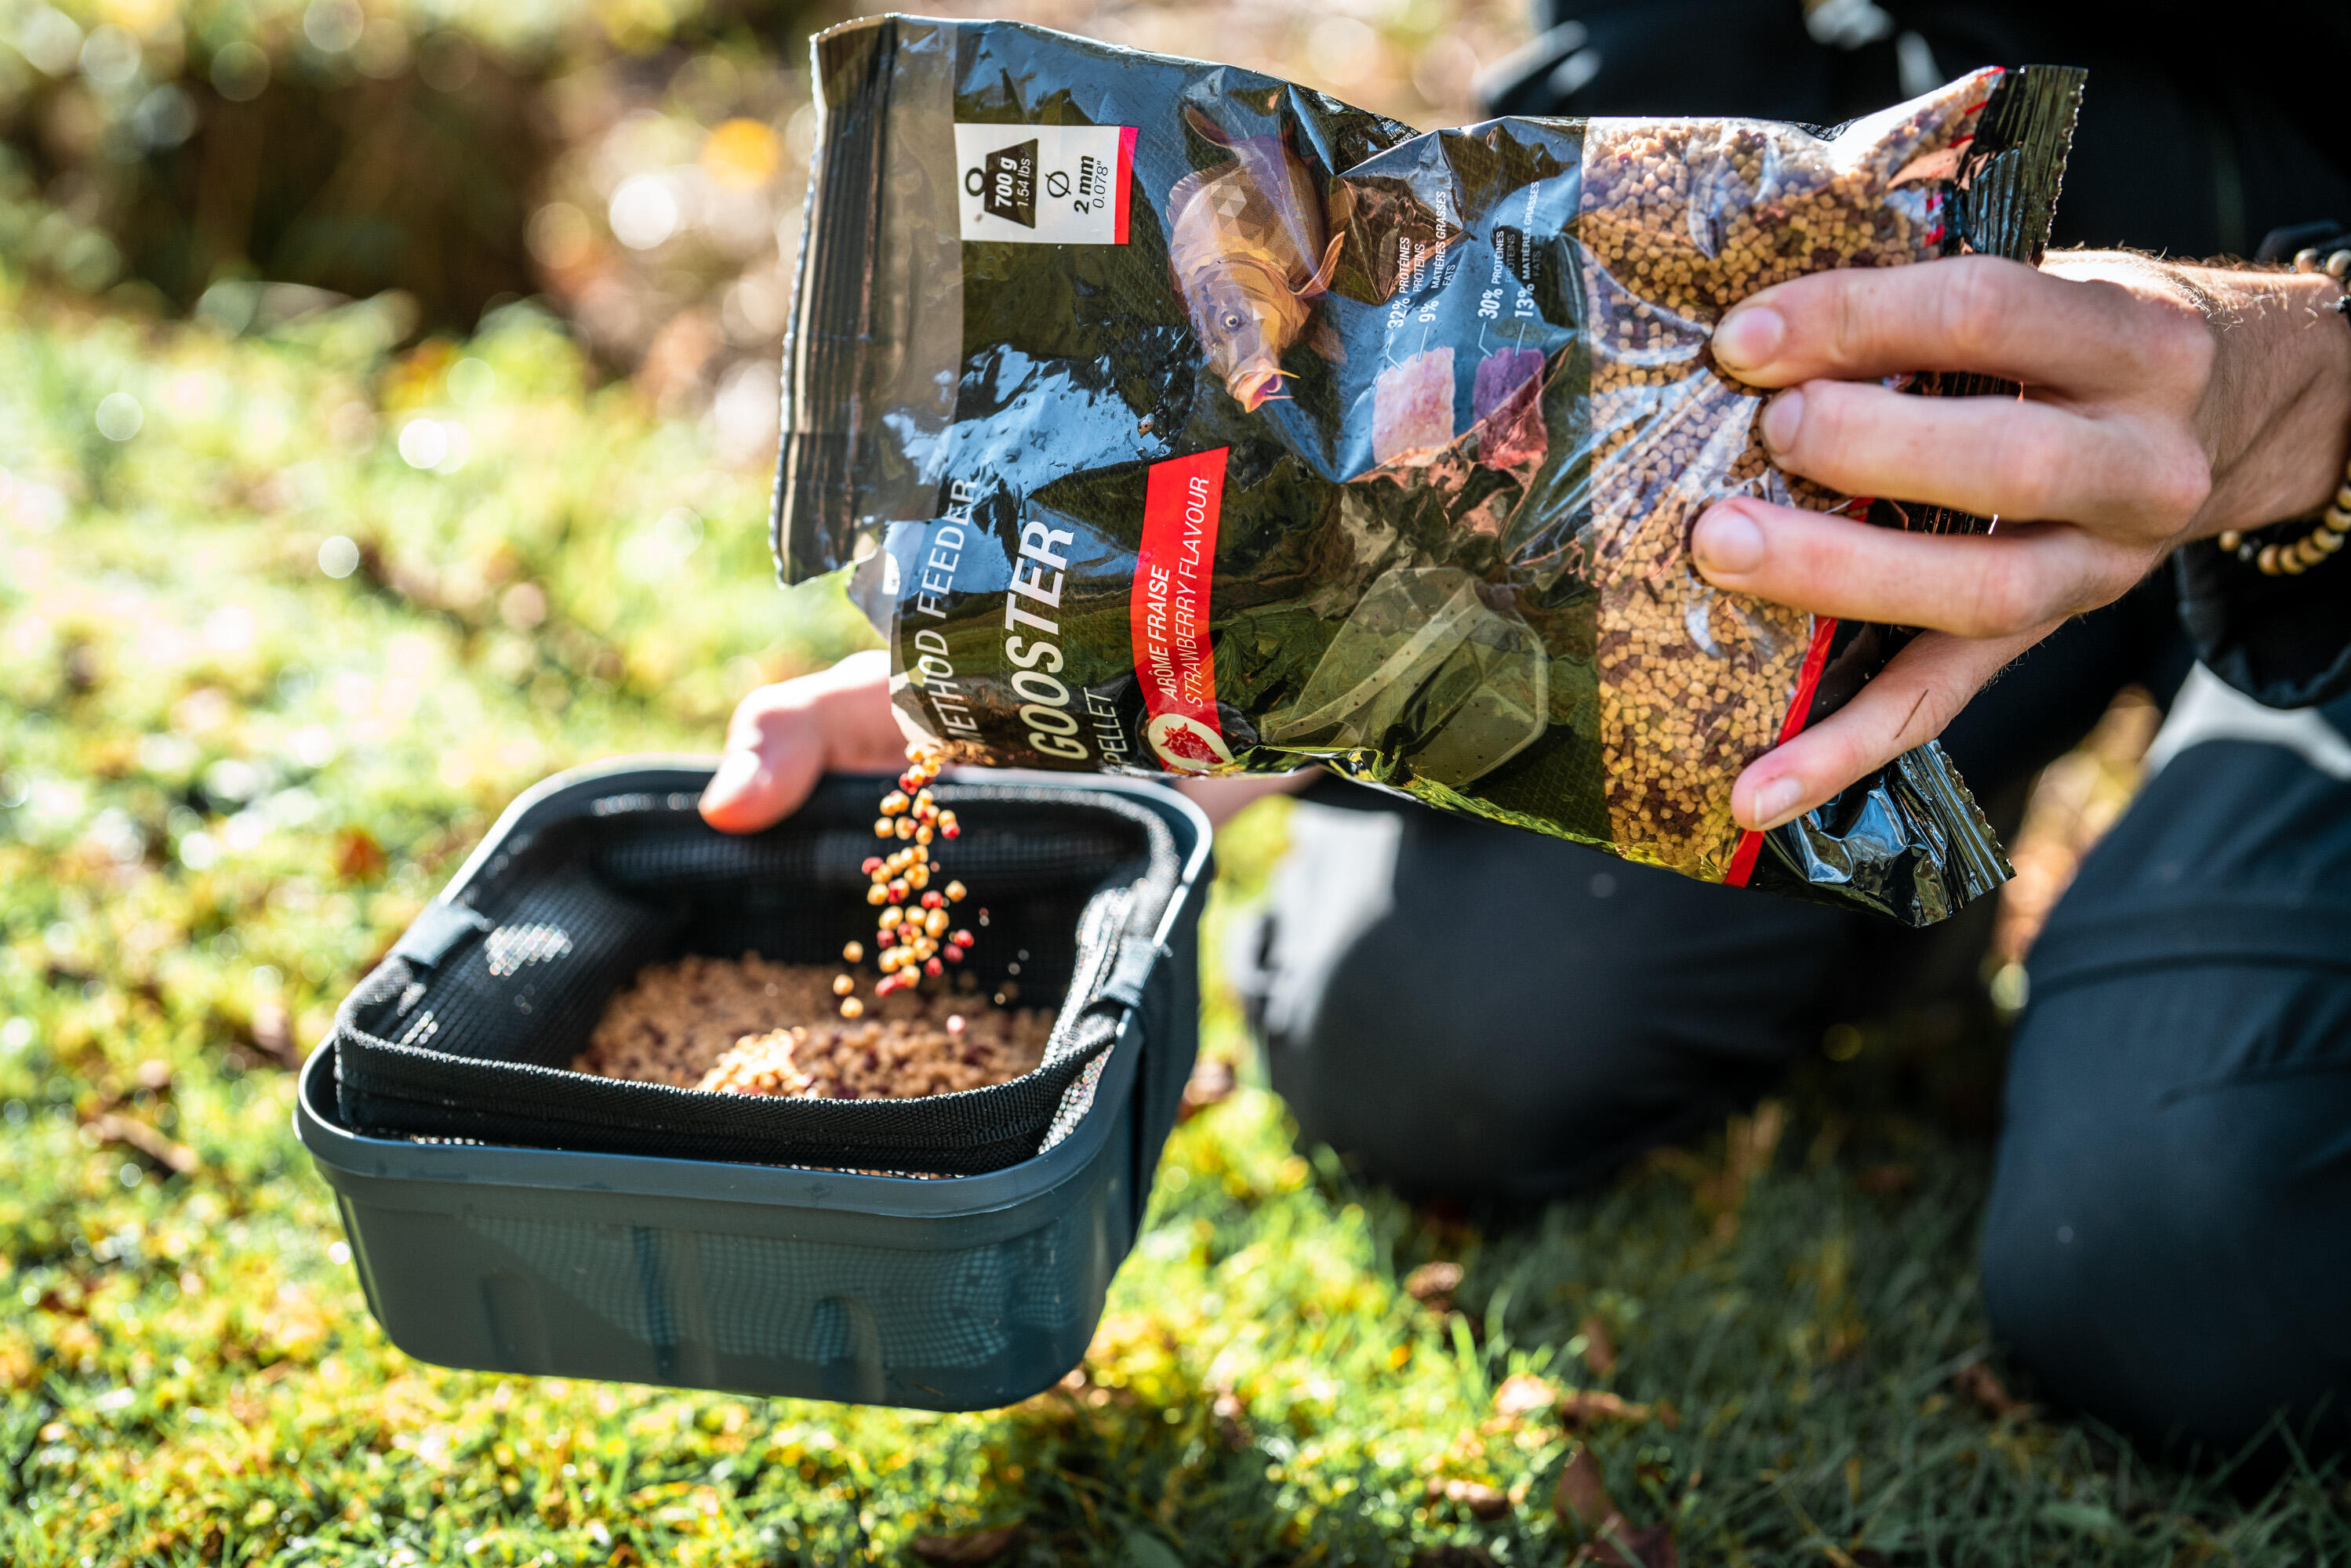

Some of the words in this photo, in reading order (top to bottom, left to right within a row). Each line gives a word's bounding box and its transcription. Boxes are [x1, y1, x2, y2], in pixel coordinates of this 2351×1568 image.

[1000, 157, 1018, 171] g
[1017, 158, 1032, 178] lbs
[1079, 155, 1096, 196] mm
[1092, 160, 1109, 209] 0.078"
[995, 172, 1014, 208] 700
[1016, 180, 1030, 207] 1.54
[1074, 199, 1090, 215] 2
[1523, 181, 1540, 225] GRASSES
[1435, 190, 1447, 240] GRASSES
[1397, 237, 1410, 294] PROTÉINES
[1412, 243, 1426, 292] PROTEINS
[1430, 240, 1446, 289] MATIÈRES
[1442, 264, 1456, 286] FATS
[1477, 288, 1503, 320] 30%
[1491, 230, 1505, 285] PROTÉINES
[1505, 234, 1516, 283] PROTEINS
[1521, 227, 1535, 280] MATIÈRES
[1532, 249, 1543, 277] FATS
[1386, 297, 1411, 328] 32%
[1418, 299, 1440, 322] 9%
[1514, 283, 1535, 318] 13%
[917, 478, 978, 619] FEEDER
[1179, 476, 1210, 579] FLAVOUR
[1147, 564, 1170, 642] FRAISE
[1005, 521, 1089, 760] GOOSTER
[1176, 579, 1204, 708] STRAWBERRY
[1148, 642, 1178, 702] ARÔME
[1083, 686, 1133, 766] PELLET
